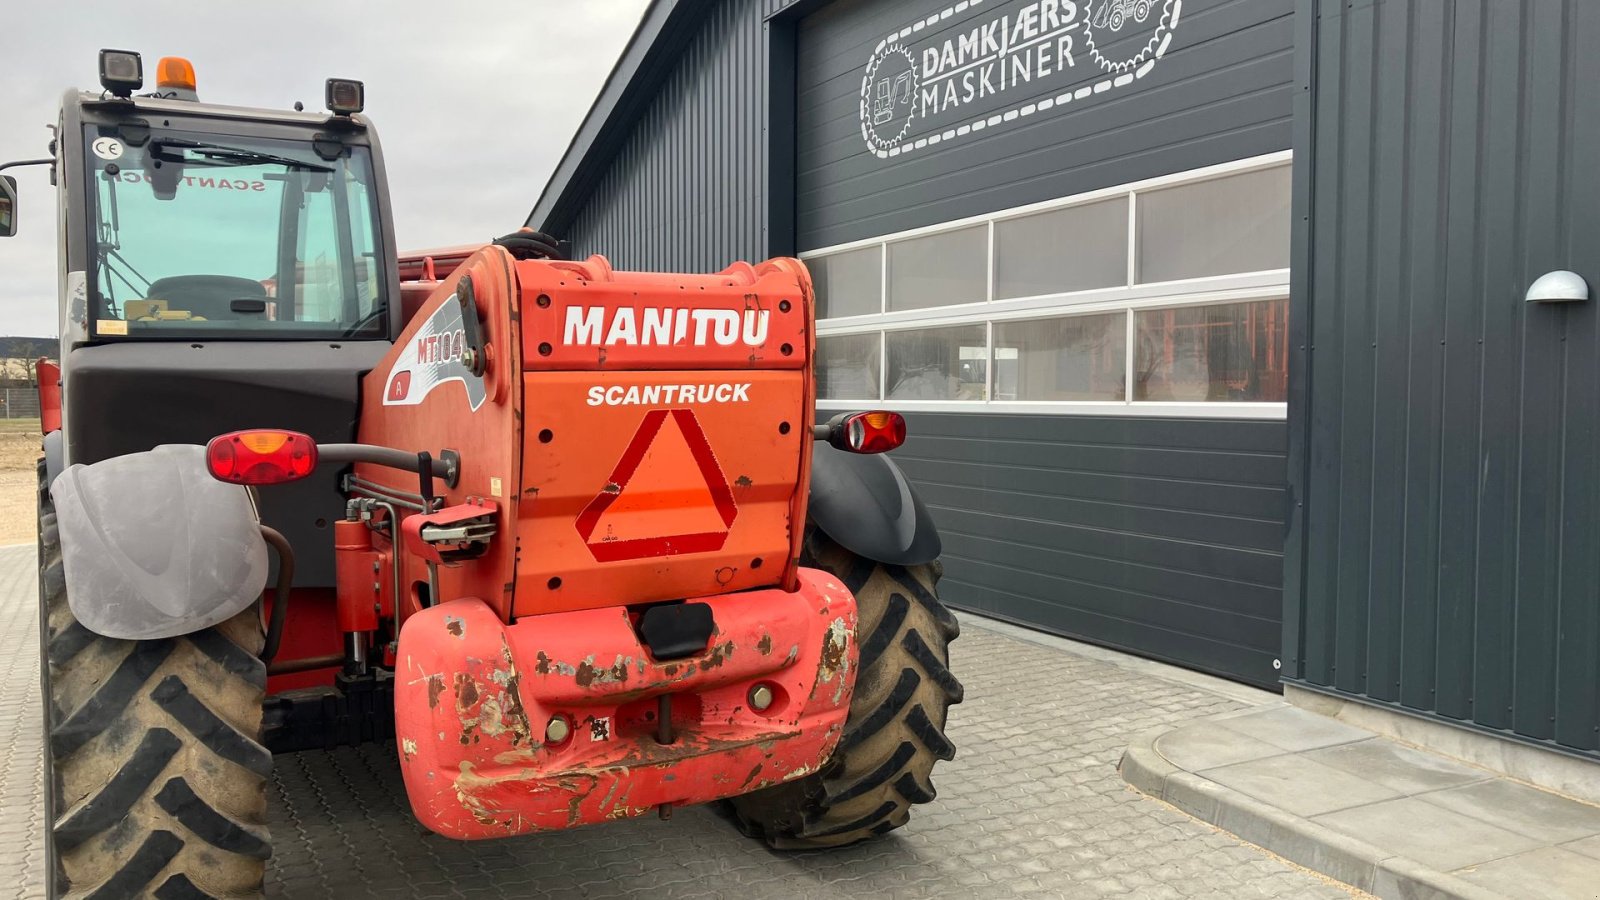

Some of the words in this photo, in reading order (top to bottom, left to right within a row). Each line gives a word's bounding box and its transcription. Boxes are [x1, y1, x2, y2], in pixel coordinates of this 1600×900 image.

[922, 0, 1077, 79] DAMKJÆRS
[921, 34, 1075, 118] MASKINER
[562, 305, 770, 346] MANITOU
[416, 329, 467, 365] MT104
[395, 381, 402, 396] A
[586, 383, 752, 406] SCANTRUCK
